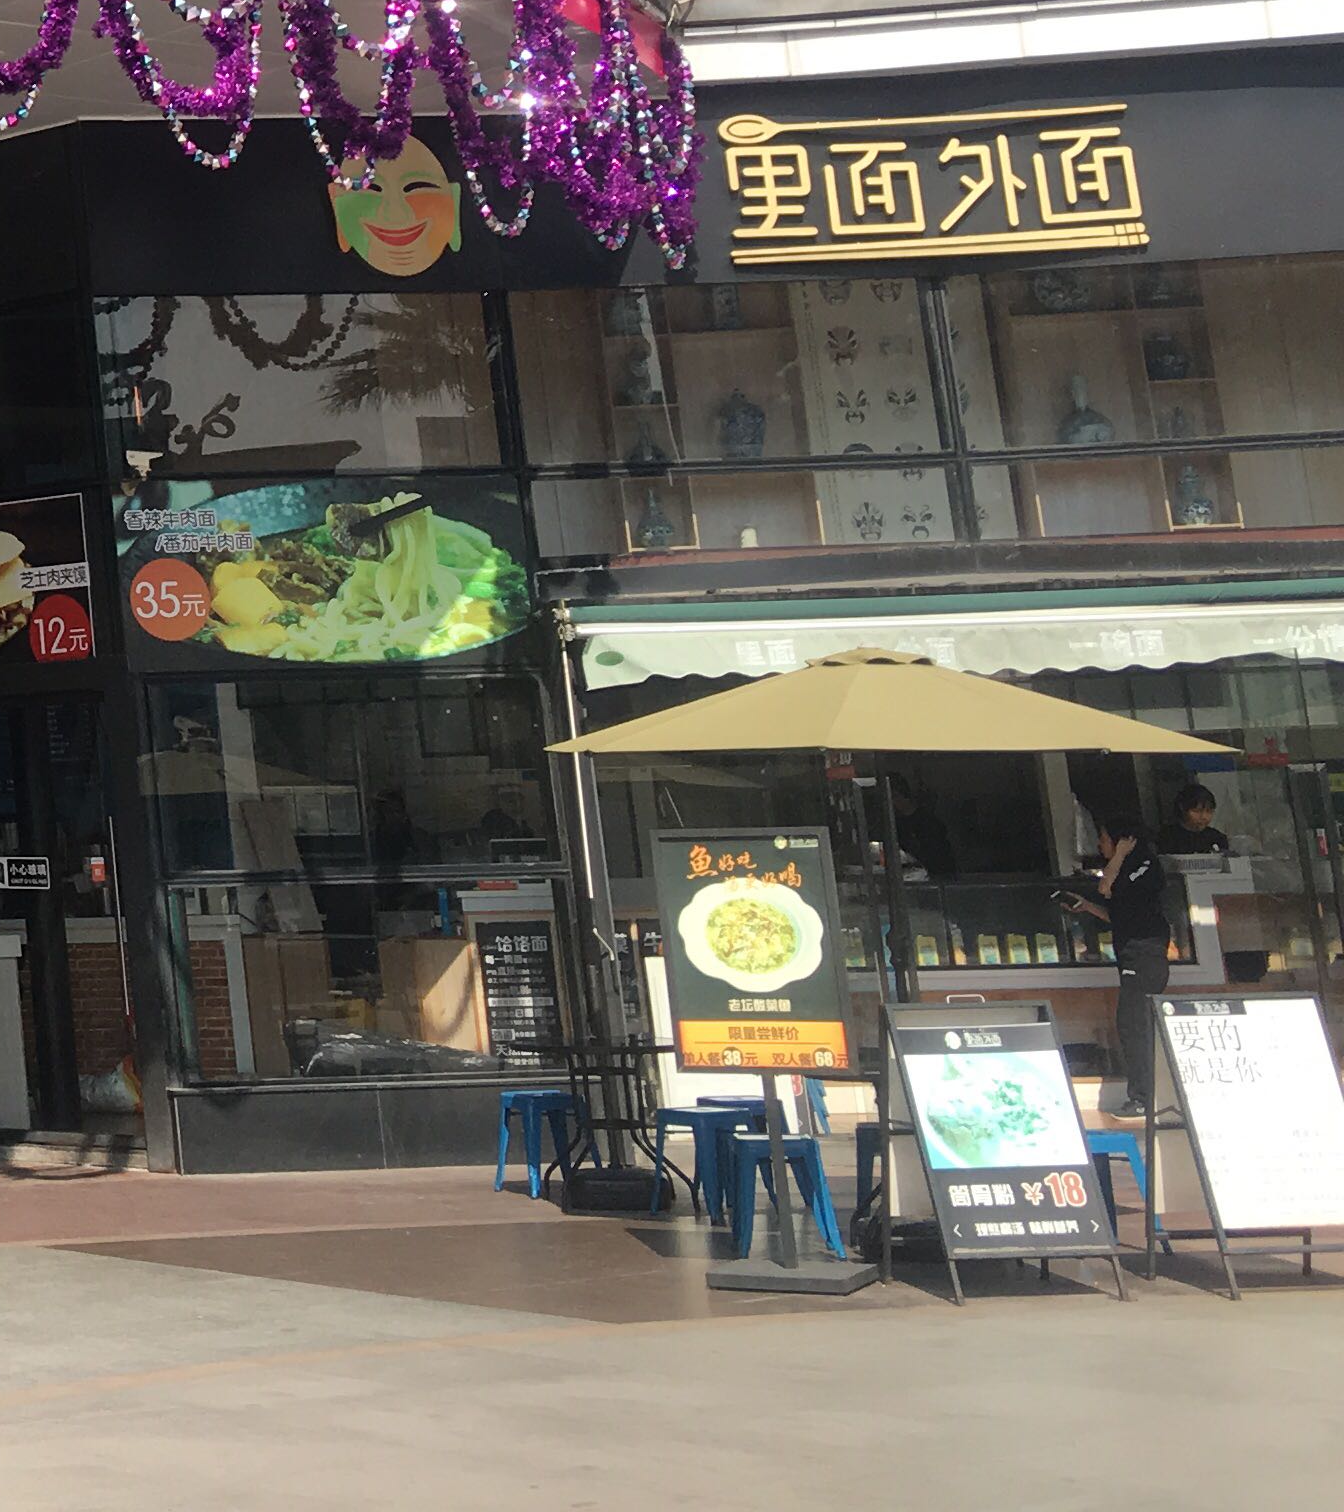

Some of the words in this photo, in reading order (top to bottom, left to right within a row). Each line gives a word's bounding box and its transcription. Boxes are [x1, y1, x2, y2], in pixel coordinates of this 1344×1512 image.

[725, 126, 1144, 238] 里面外面
[124, 508, 215, 531] 香辣牛肉面
[135, 580, 207, 619] 35元
[34, 616, 89, 656] 12元
[9, 863, 47, 877] 小心玻璃
[728, 1026, 800, 1041] 限量尝鲜价
[1170, 1018, 1242, 1054] 要的
[1178, 1056, 1264, 1084] 就是你
